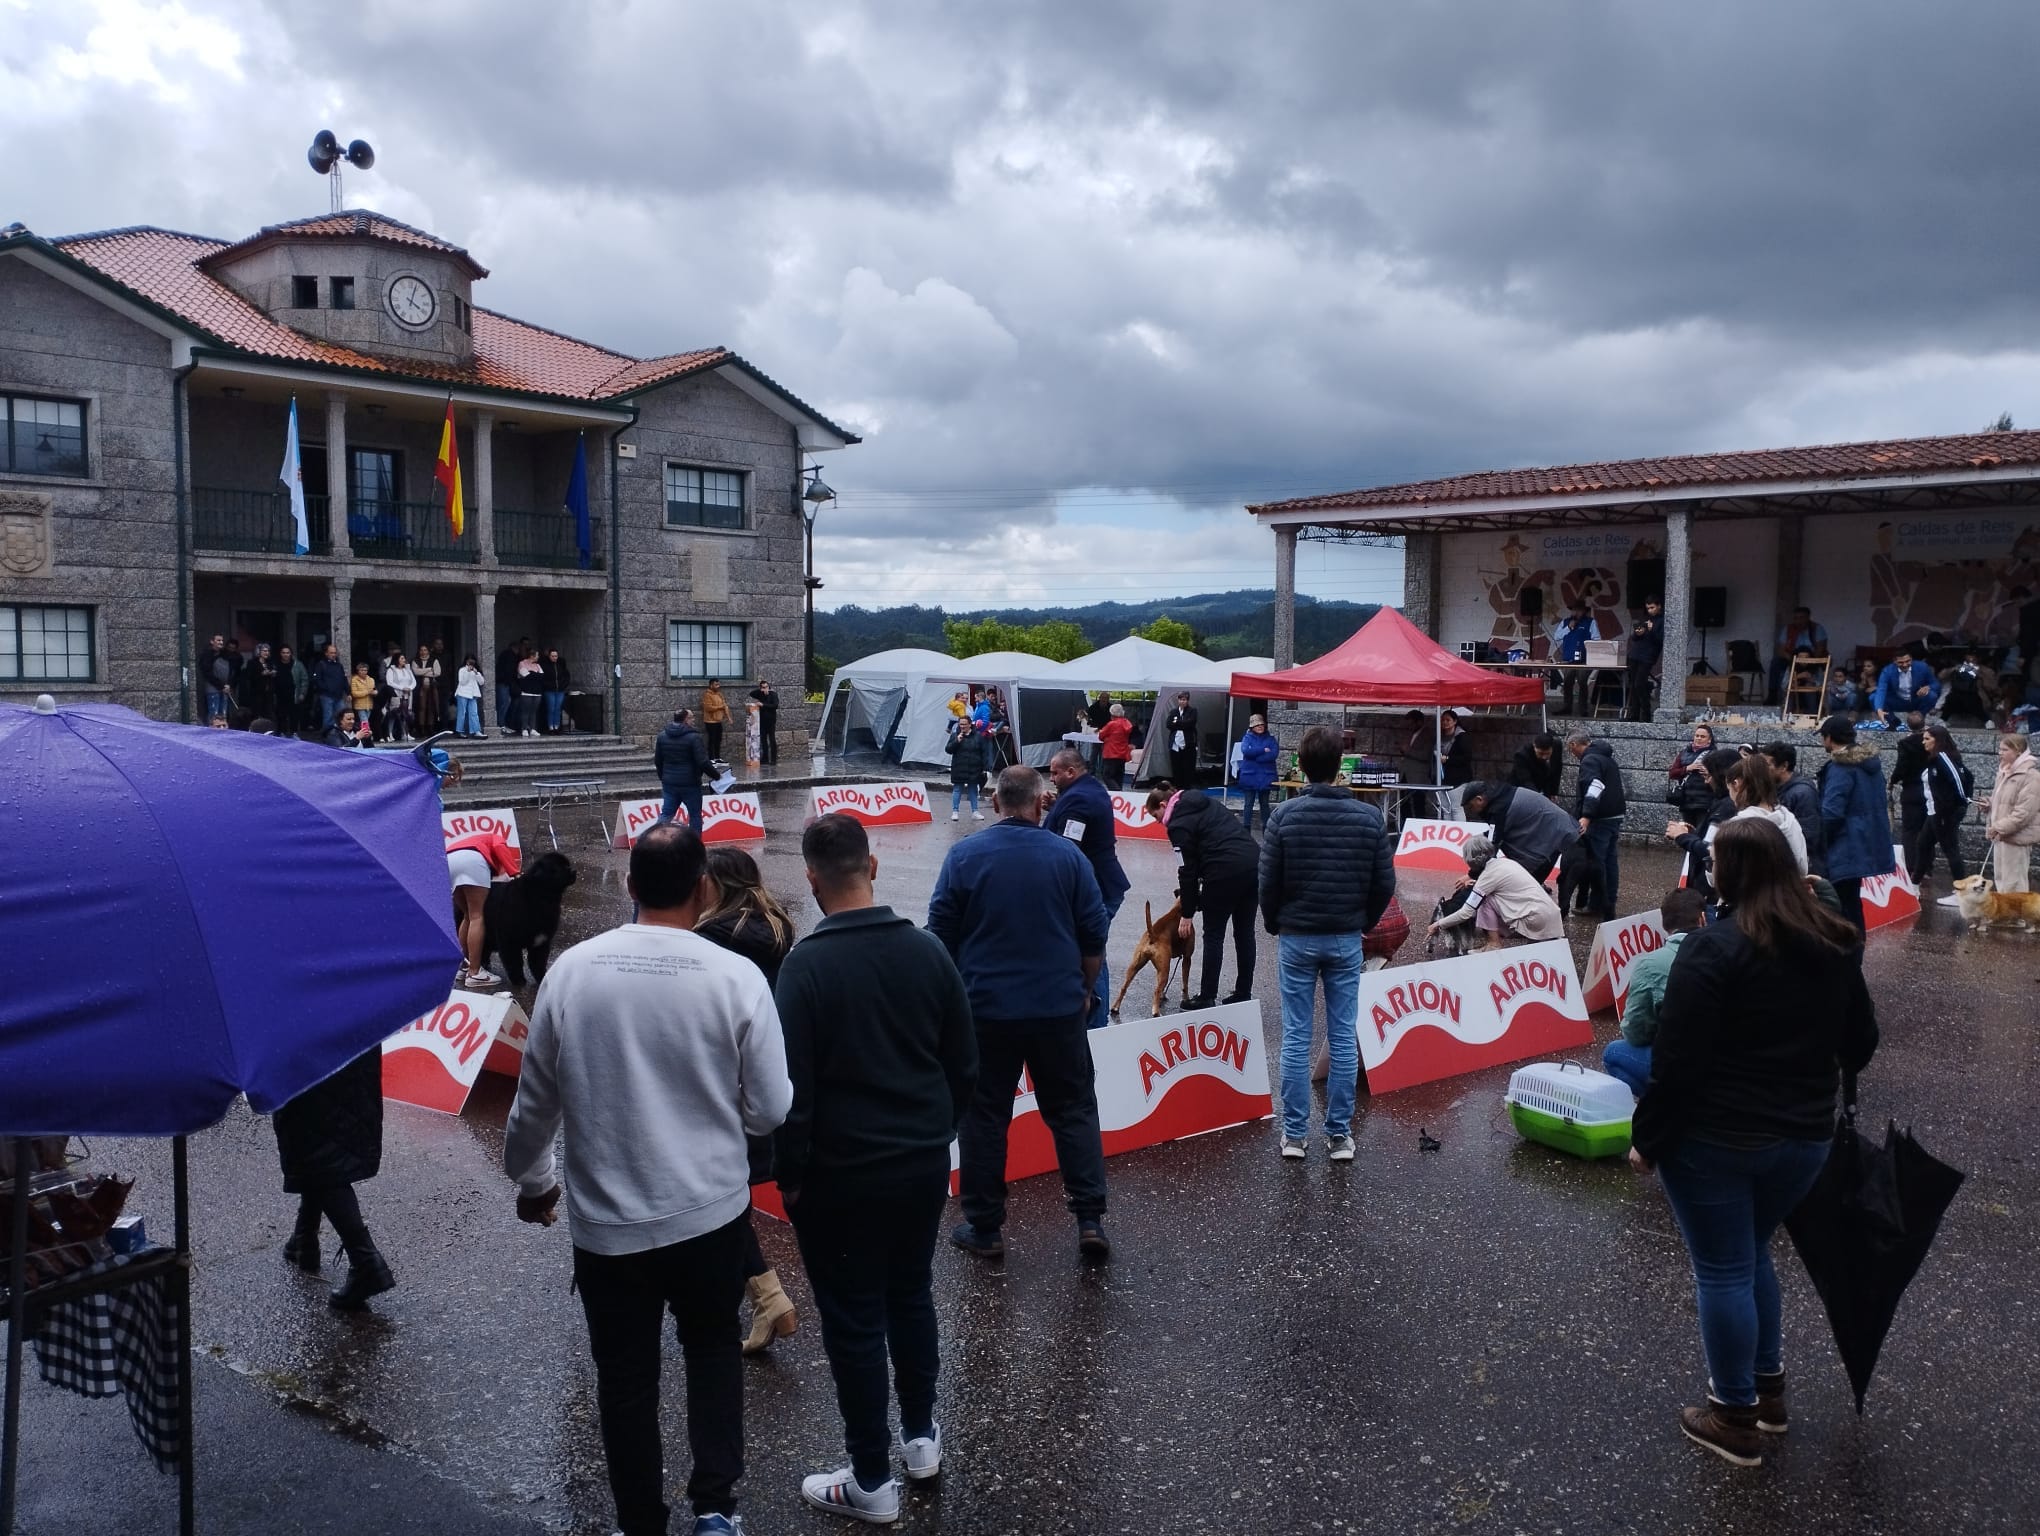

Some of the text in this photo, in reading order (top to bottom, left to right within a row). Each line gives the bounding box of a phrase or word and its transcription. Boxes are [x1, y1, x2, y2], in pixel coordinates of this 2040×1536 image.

[1543, 534, 1630, 549] Caldas de Reis
[1954, 520, 1976, 534] de
[817, 786, 924, 814] ARION ARION
[627, 803, 690, 832] ARIN
[1370, 979, 1462, 1046] ARION
[1489, 960, 1567, 1019] ARION
[402, 1002, 488, 1066] ION
[1137, 1022, 1250, 1101] ARION
